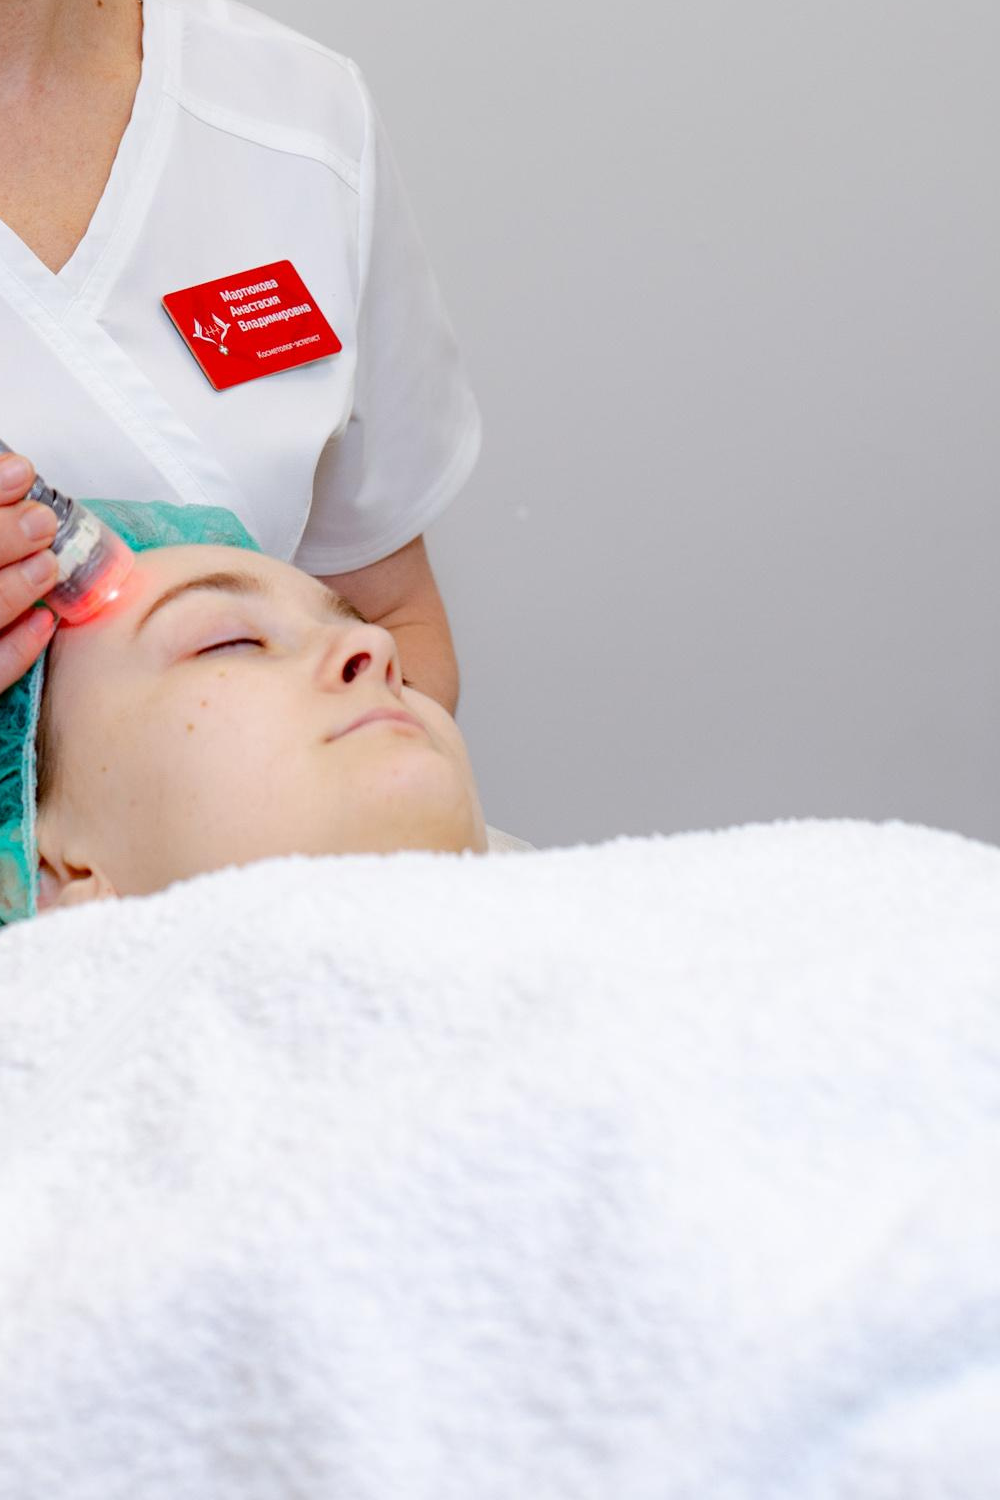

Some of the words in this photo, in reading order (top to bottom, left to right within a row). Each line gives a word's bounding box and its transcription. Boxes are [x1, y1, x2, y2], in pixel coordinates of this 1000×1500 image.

[219, 278, 278, 302] Мартюкова
[229, 295, 281, 317] Анастасия
[237, 303, 312, 332] Владимировна
